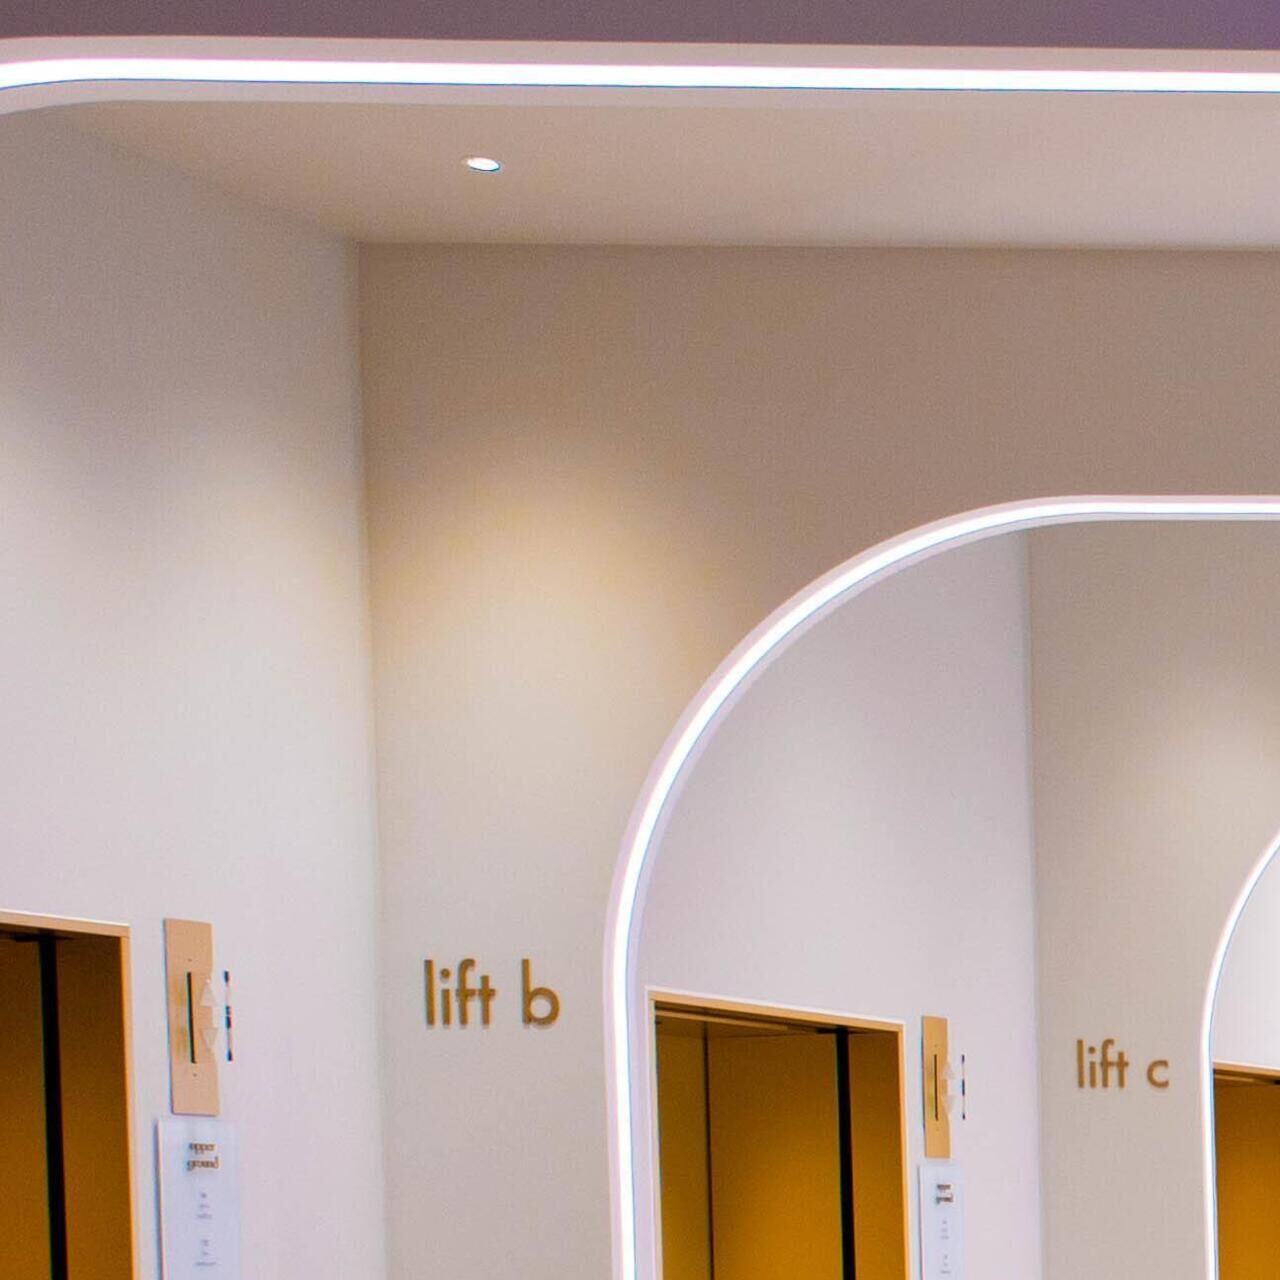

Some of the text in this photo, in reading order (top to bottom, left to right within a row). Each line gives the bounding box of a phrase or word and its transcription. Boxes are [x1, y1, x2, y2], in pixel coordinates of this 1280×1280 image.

[424, 958, 560, 1026] lift b
[1076, 1038, 1170, 1089] lift c
